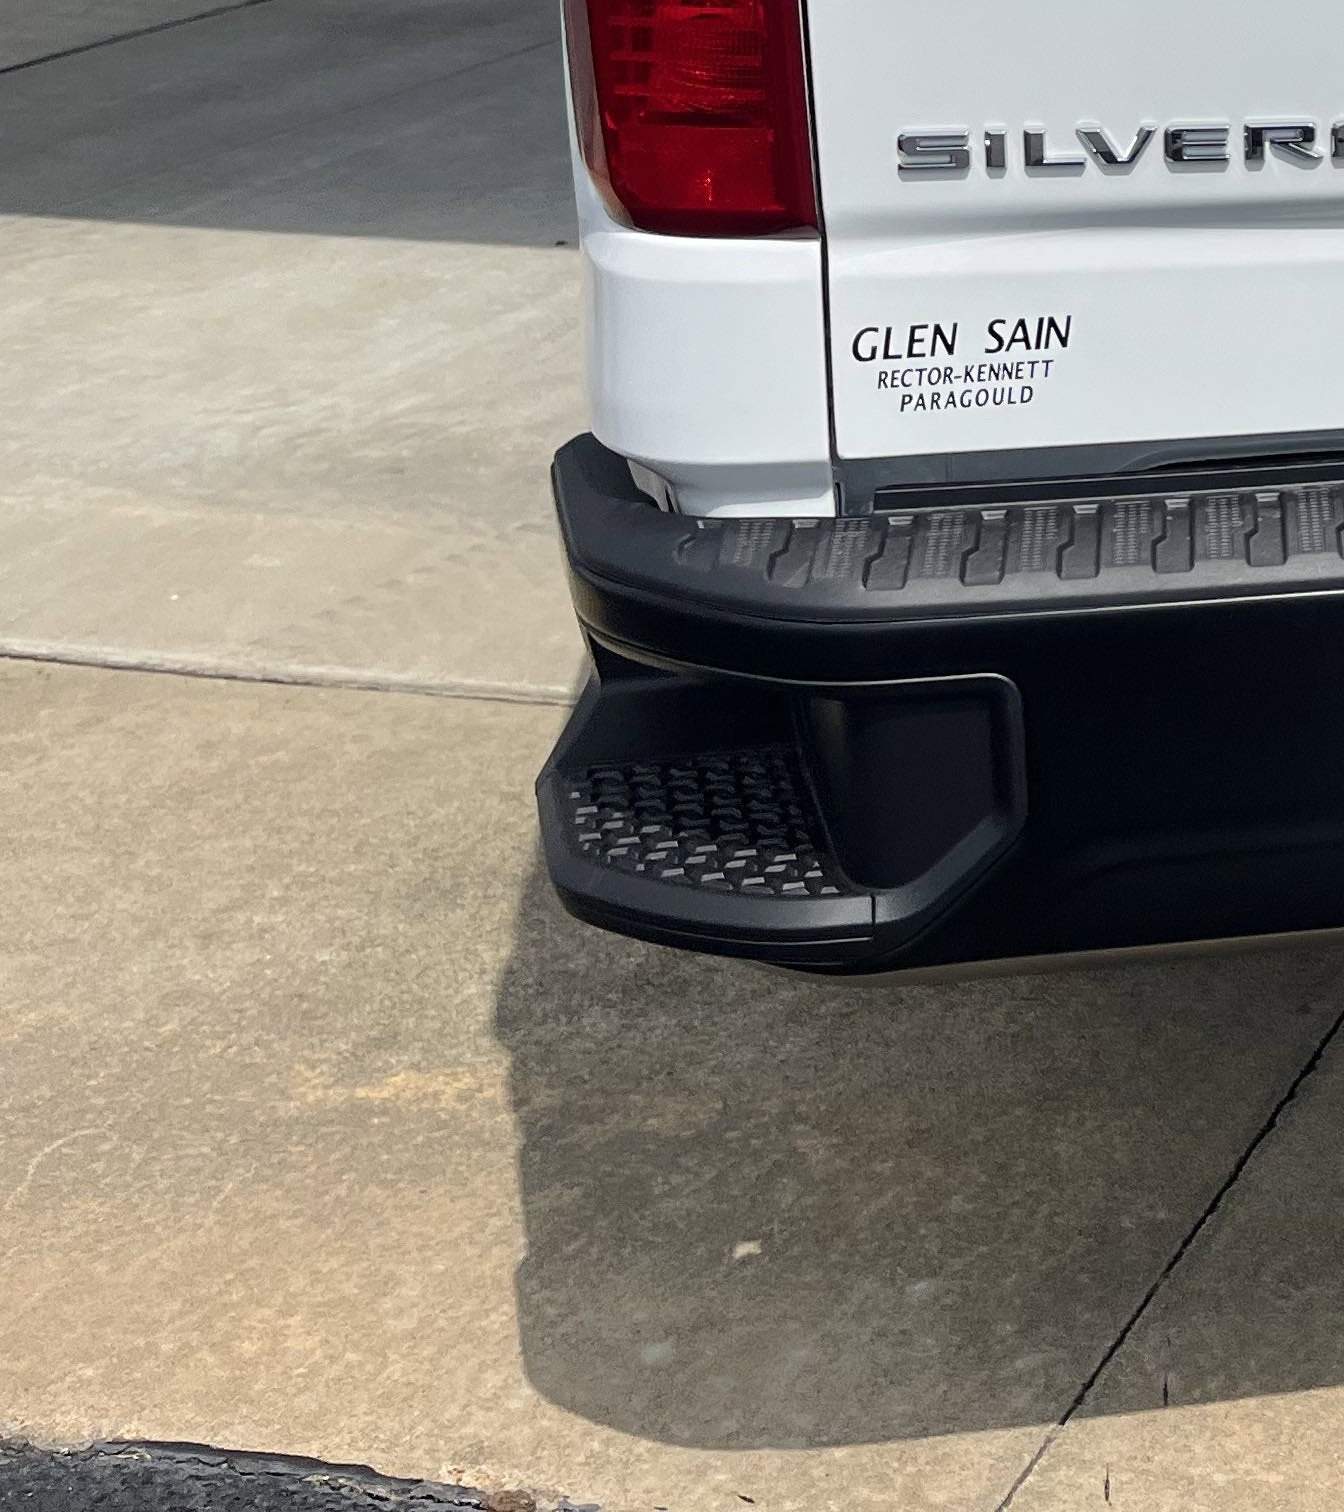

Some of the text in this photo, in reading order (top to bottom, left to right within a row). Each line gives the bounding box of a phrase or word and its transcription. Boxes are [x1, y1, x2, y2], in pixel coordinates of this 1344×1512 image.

[852, 315, 1072, 362] GLEN SAIN
[877, 359, 1054, 389] RECTOR-KENNETT
[899, 386, 1034, 412] PARAGOULD
